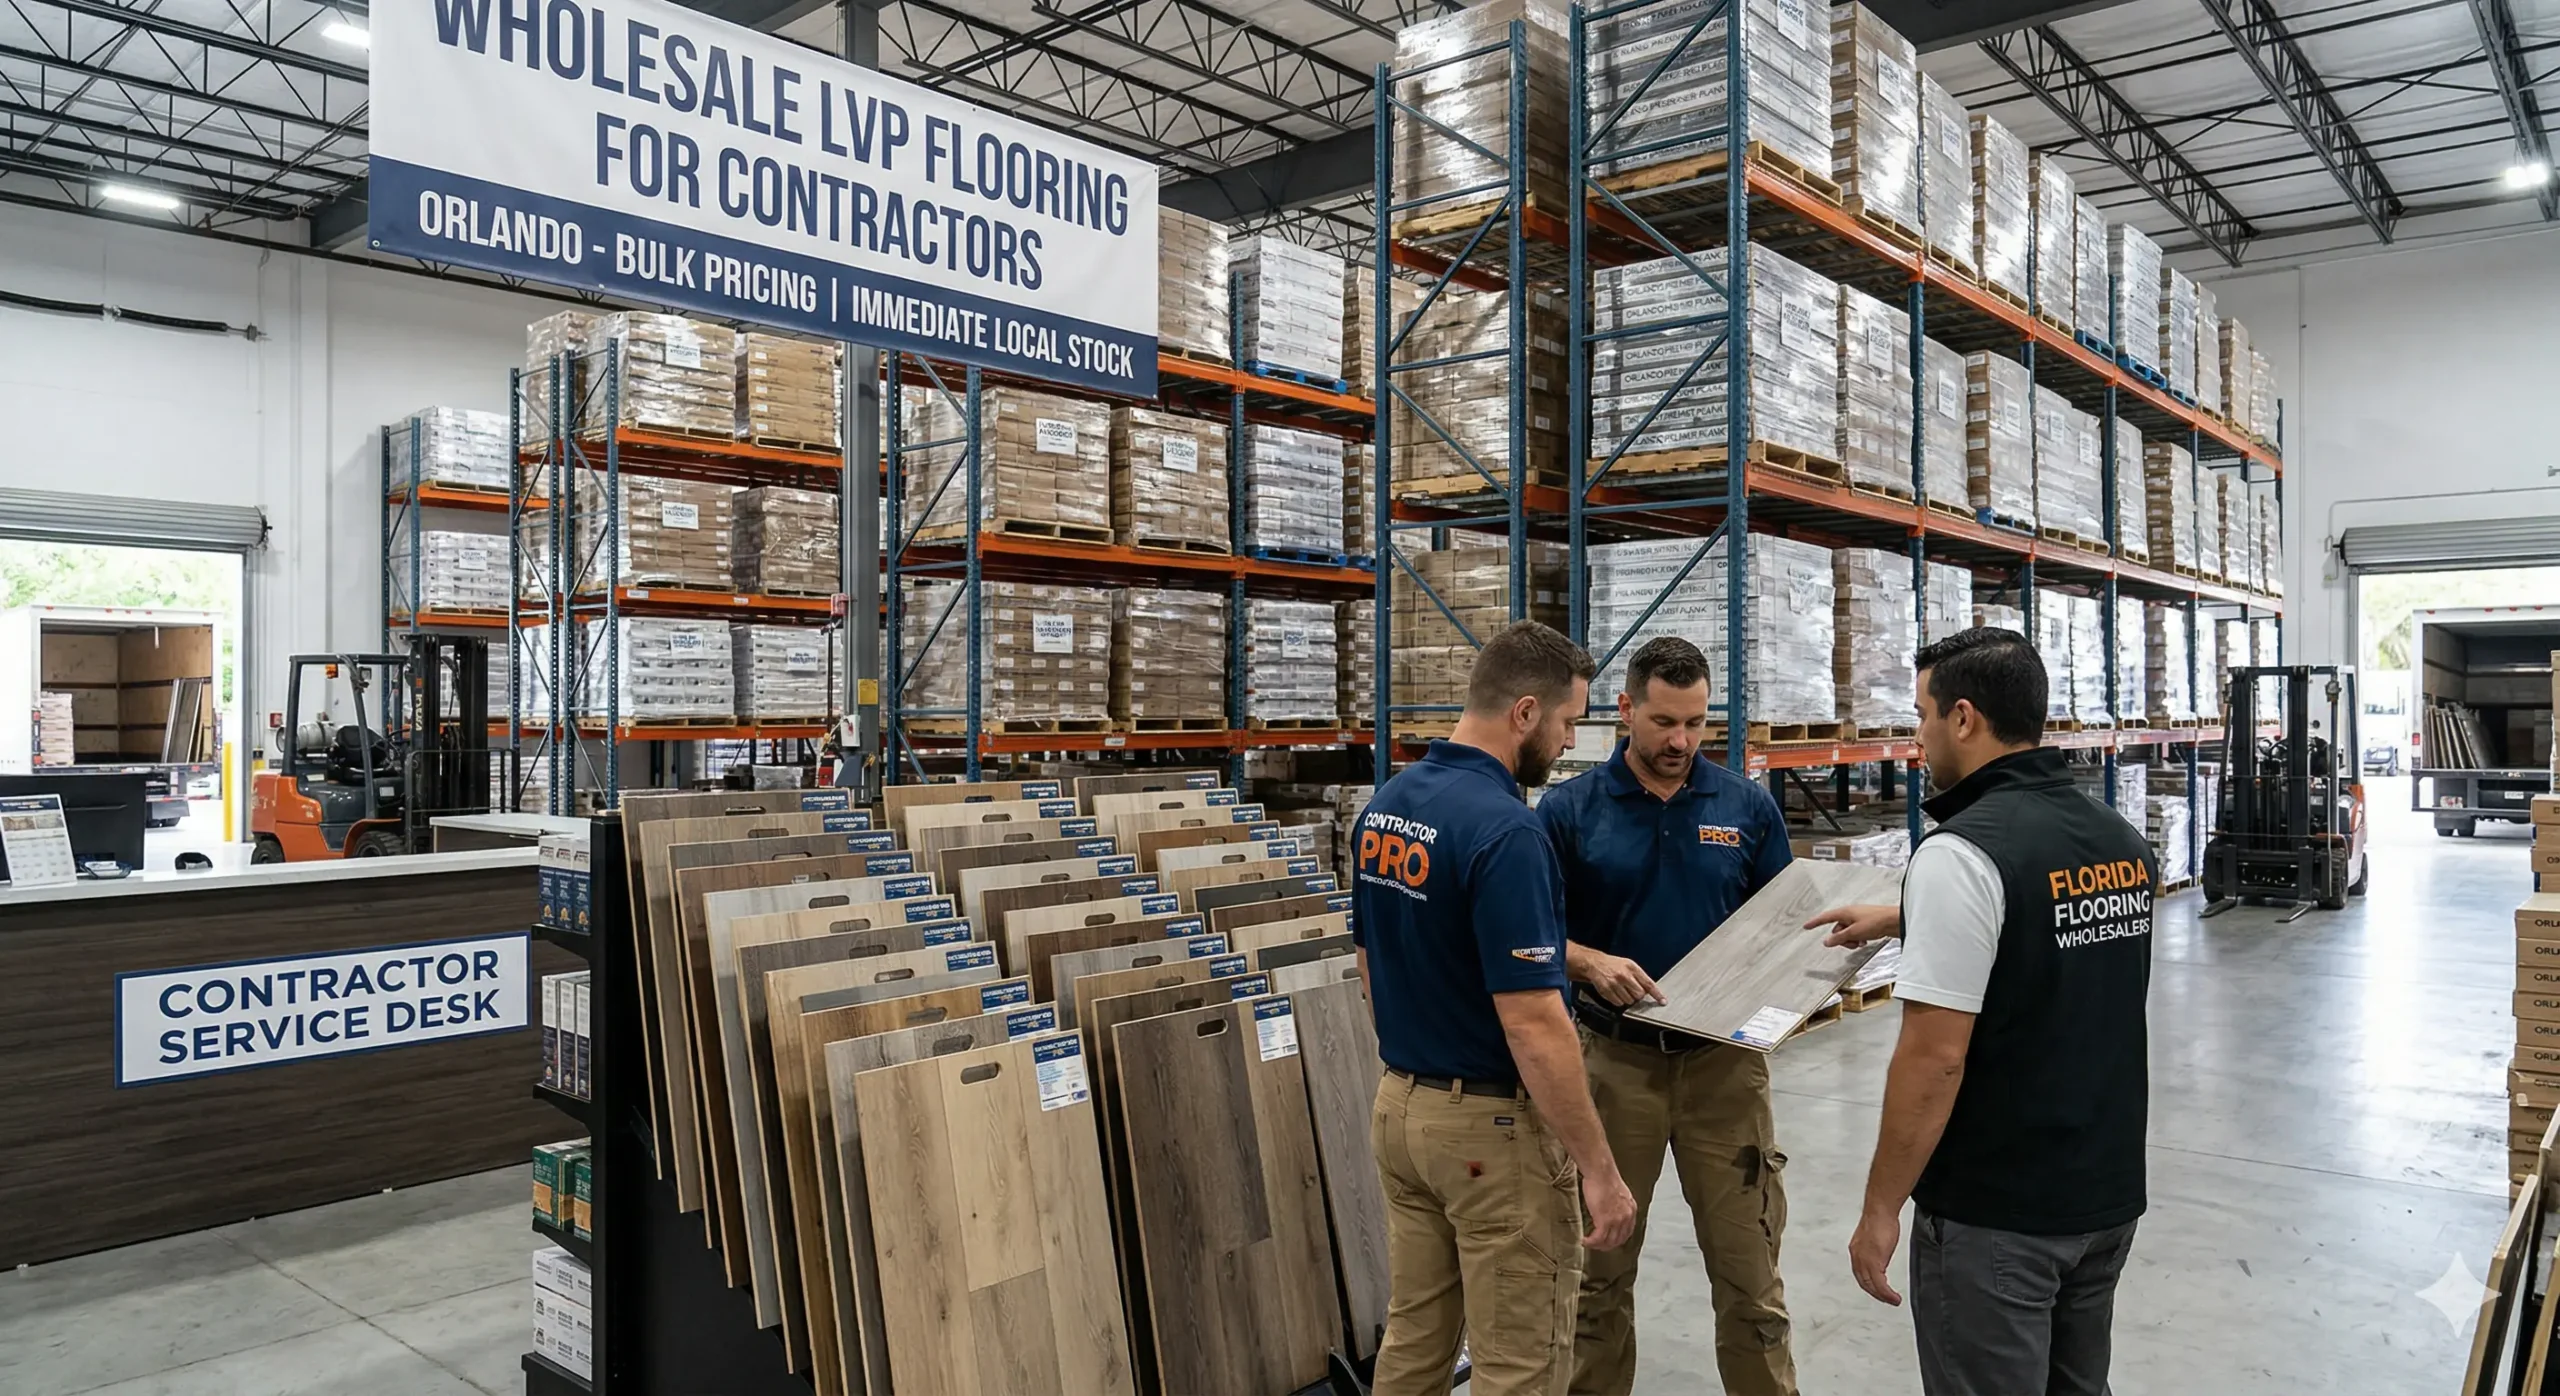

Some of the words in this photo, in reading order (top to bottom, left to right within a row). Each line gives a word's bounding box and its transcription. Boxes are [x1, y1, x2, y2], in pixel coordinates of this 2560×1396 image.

[435, 0, 802, 144] WHOLESALE
[820, 80, 910, 170] LVP
[924, 116, 1128, 236] FLOORING
[596, 112, 701, 209] FOR
[718, 146, 1043, 291] CONTRACTORS
[418, 190, 583, 265] ORLANDO
[616, 237, 695, 289] BULK
[704, 253, 817, 312] PRICING
[852, 291, 988, 349] IMMEDIATE
[995, 319, 1064, 366] LOCAL
[1068, 333, 1134, 379] STOCK
[1364, 812, 1437, 844] CONTRACTOR
[1699, 829, 1740, 844] PRO
[1360, 830, 1429, 886] PRO
[2049, 858, 2149, 899] FLORIDA
[2054, 890, 2150, 927] FLOORING
[2055, 918, 2150, 949] WHOLESALERS
[158, 949, 500, 1018] CONTRACTOR
[158, 1005, 370, 1064] SERVICE
[386, 988, 501, 1034] DESK
